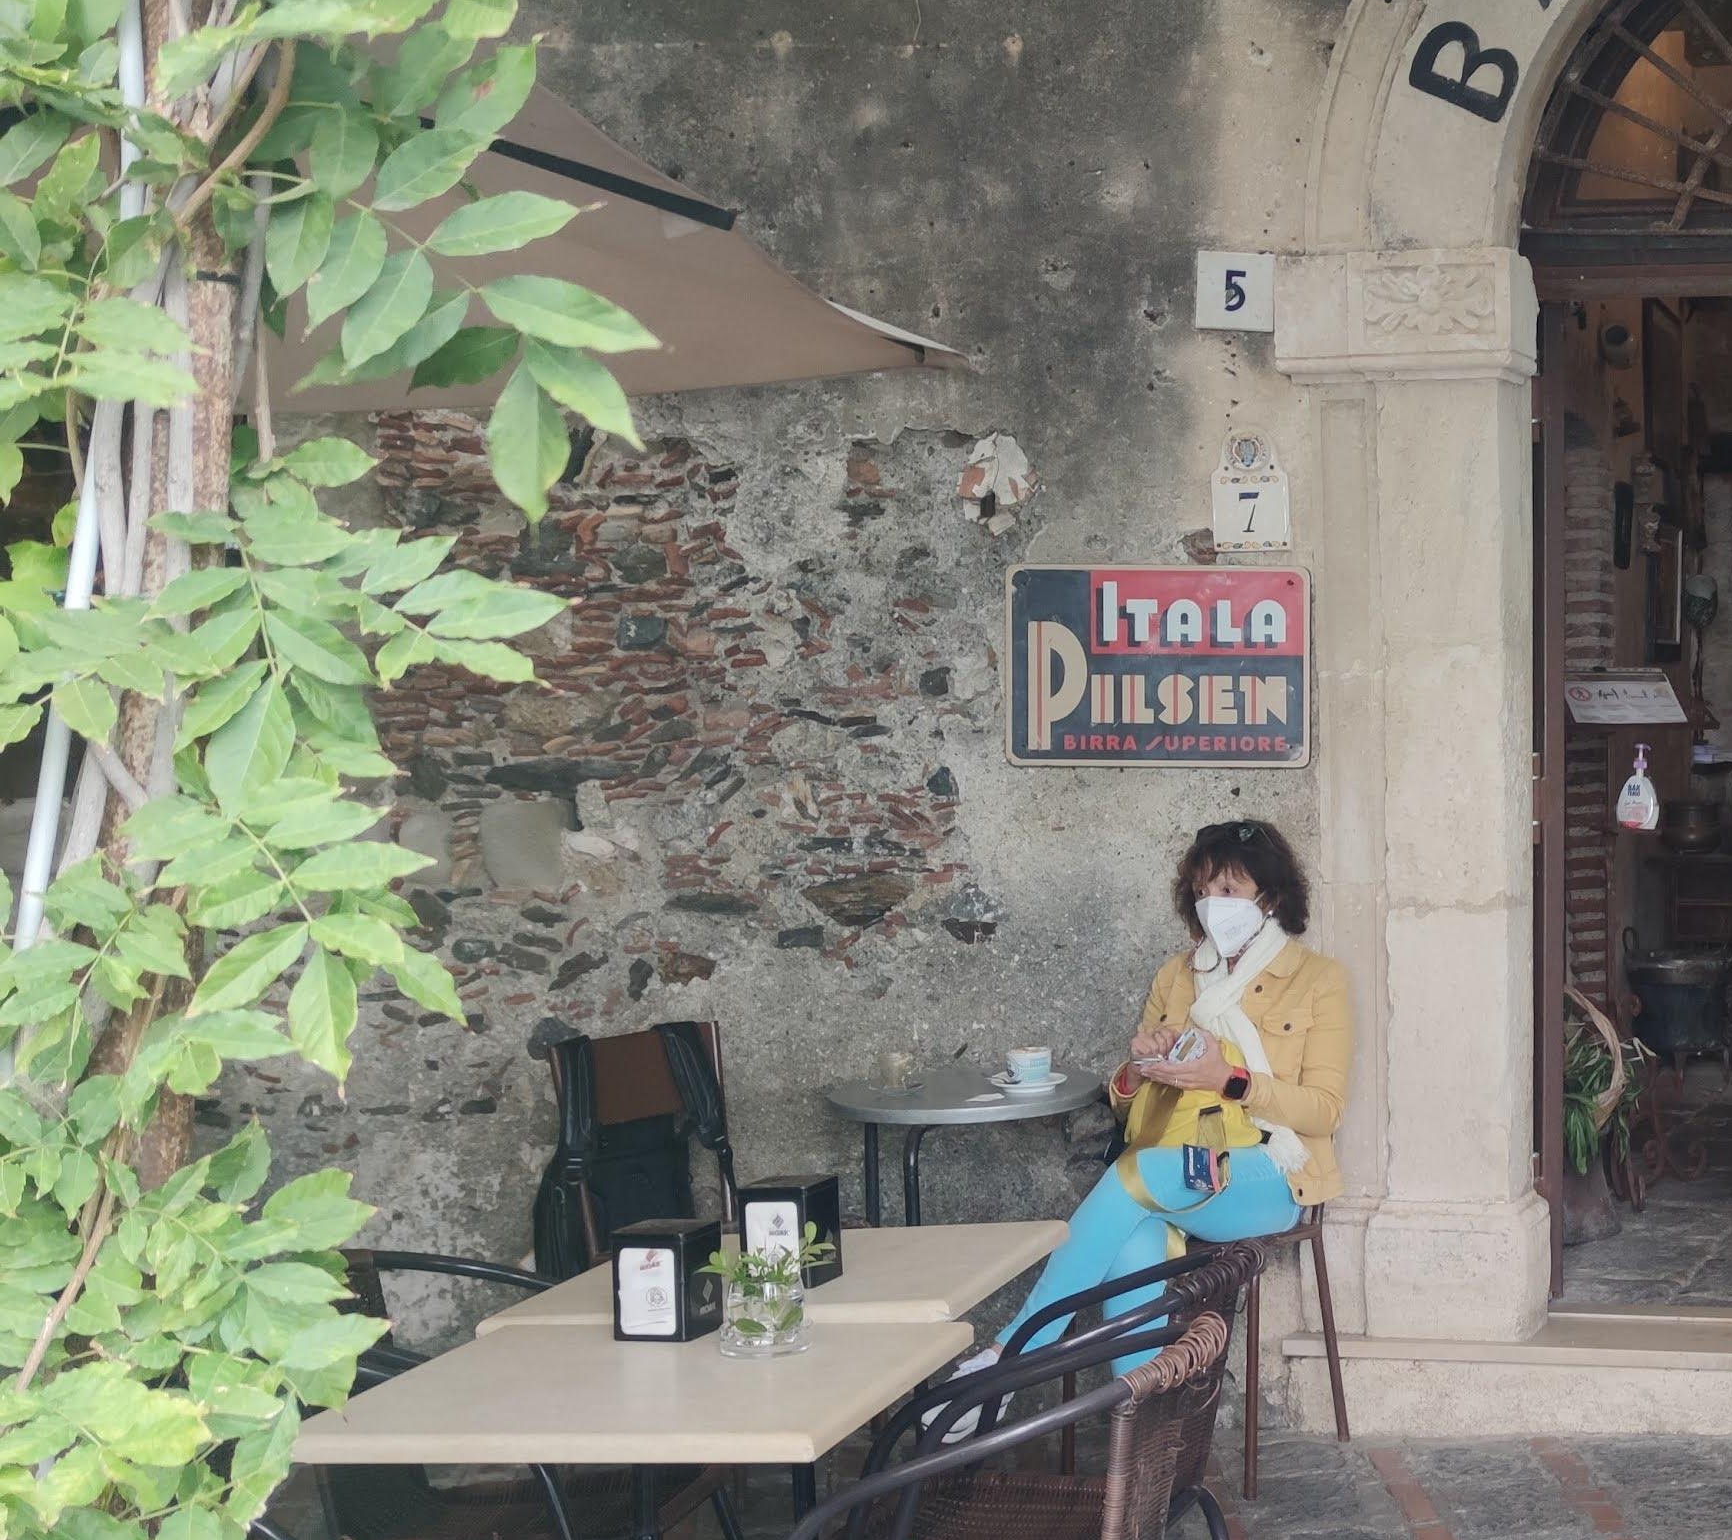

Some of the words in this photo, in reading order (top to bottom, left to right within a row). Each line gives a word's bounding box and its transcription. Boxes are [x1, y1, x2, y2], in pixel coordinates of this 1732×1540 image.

[1224, 269, 1247, 312] 5
[1238, 491, 1260, 533] 7
[1101, 580, 1287, 645] ITALA
[1027, 620, 1288, 751] PILSEN
[1063, 734, 1138, 751] BIRRA
[1144, 734, 1287, 753] SUPERIORE
